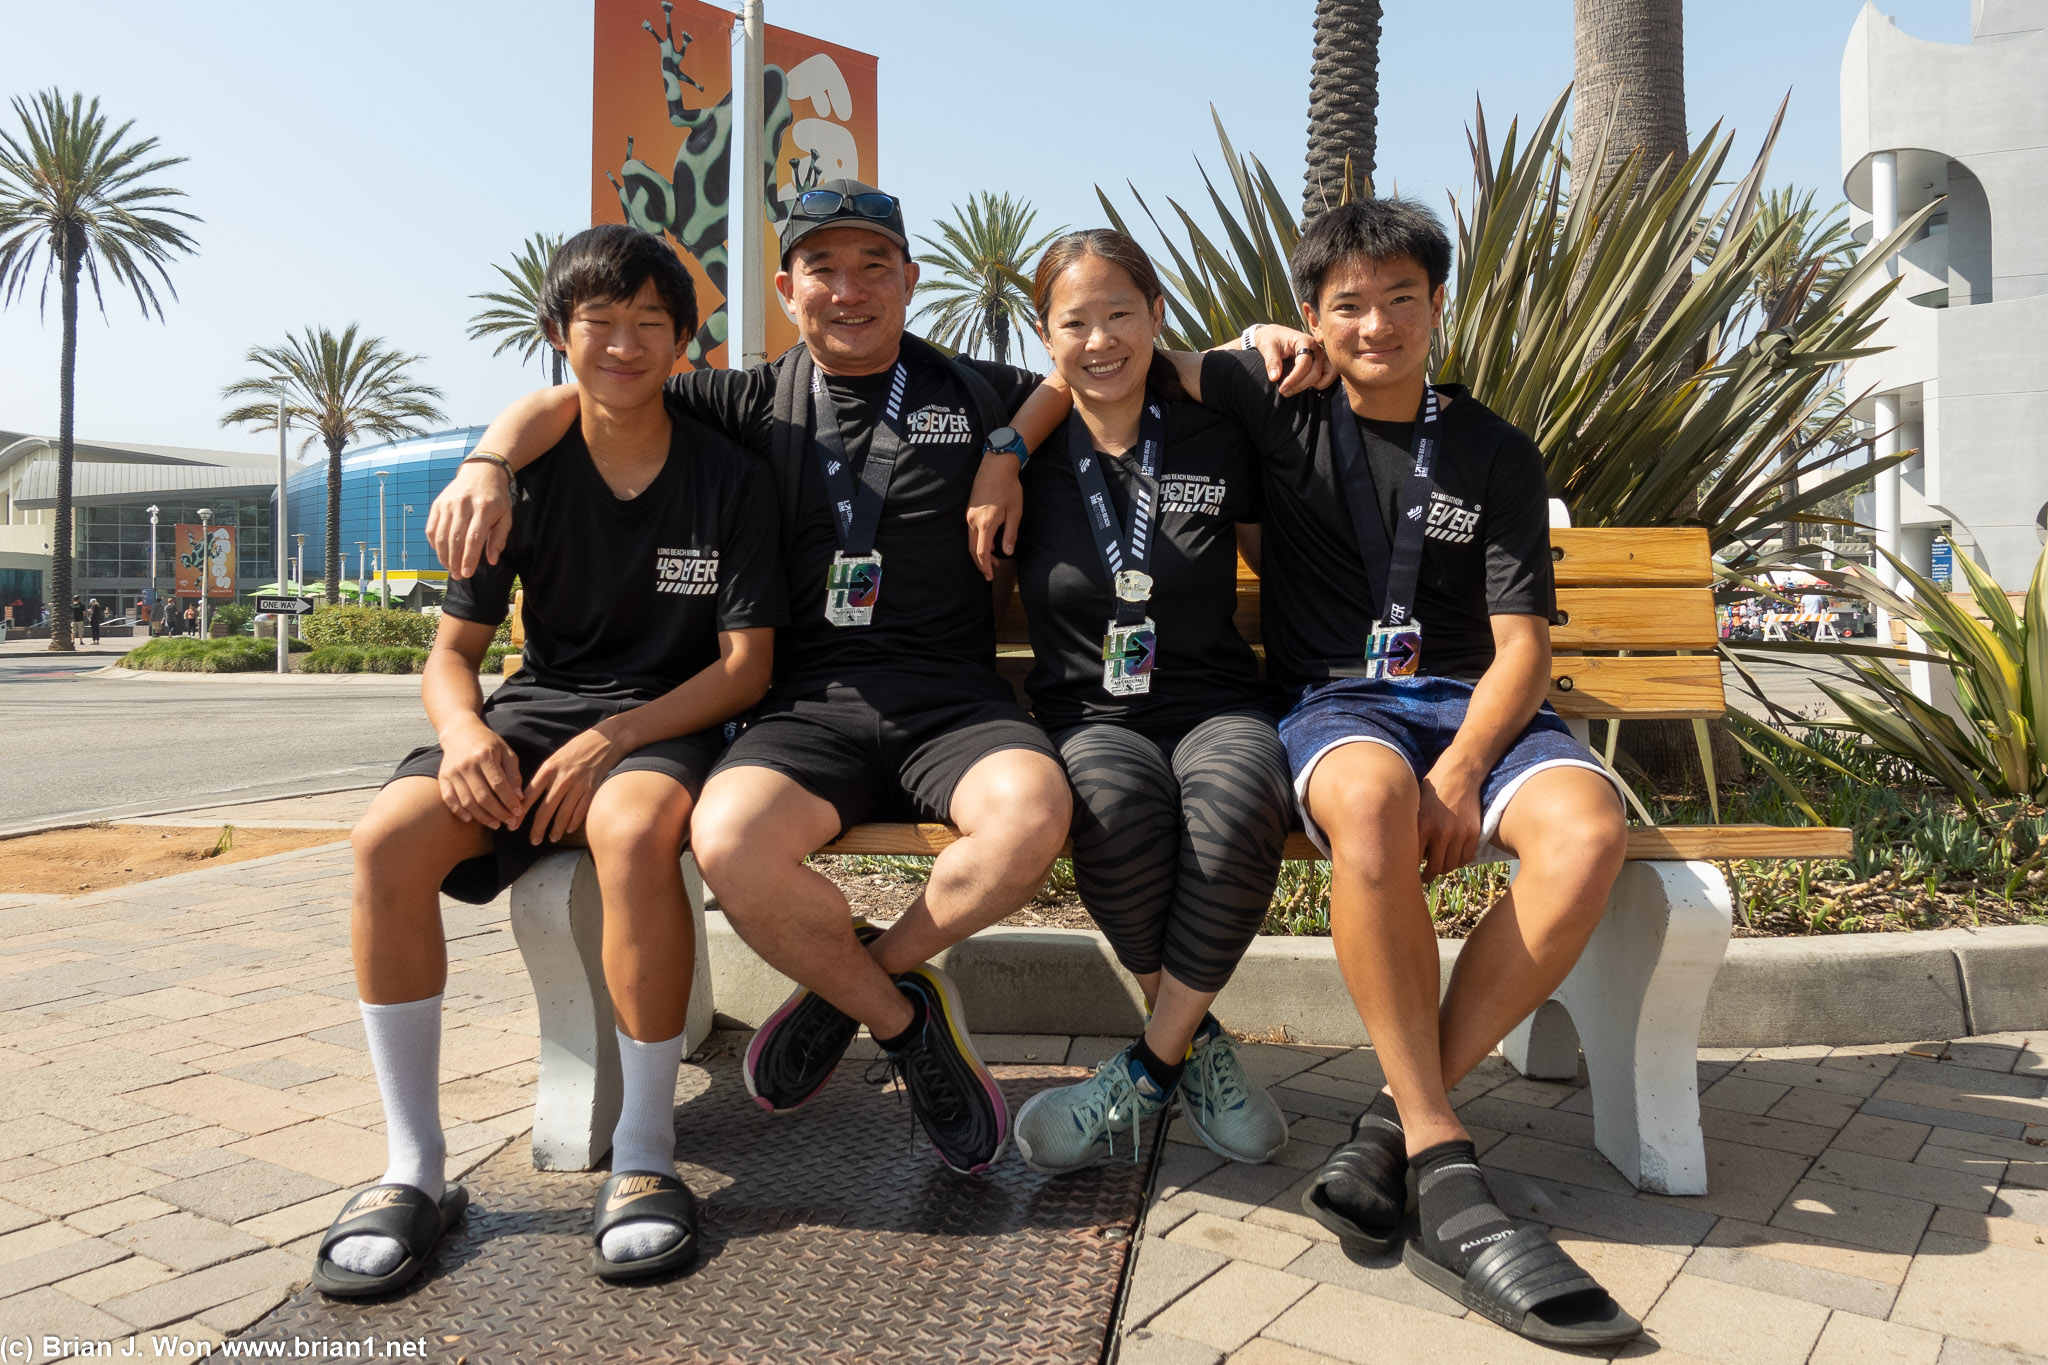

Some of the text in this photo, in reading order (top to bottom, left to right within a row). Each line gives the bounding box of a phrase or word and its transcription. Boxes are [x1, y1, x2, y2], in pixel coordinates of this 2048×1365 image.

[1427, 501, 1480, 533] EVER
[1390, 604, 1405, 626] VER
[614, 1176, 662, 1196] NIKE
[352, 1188, 403, 1210] NIKE
